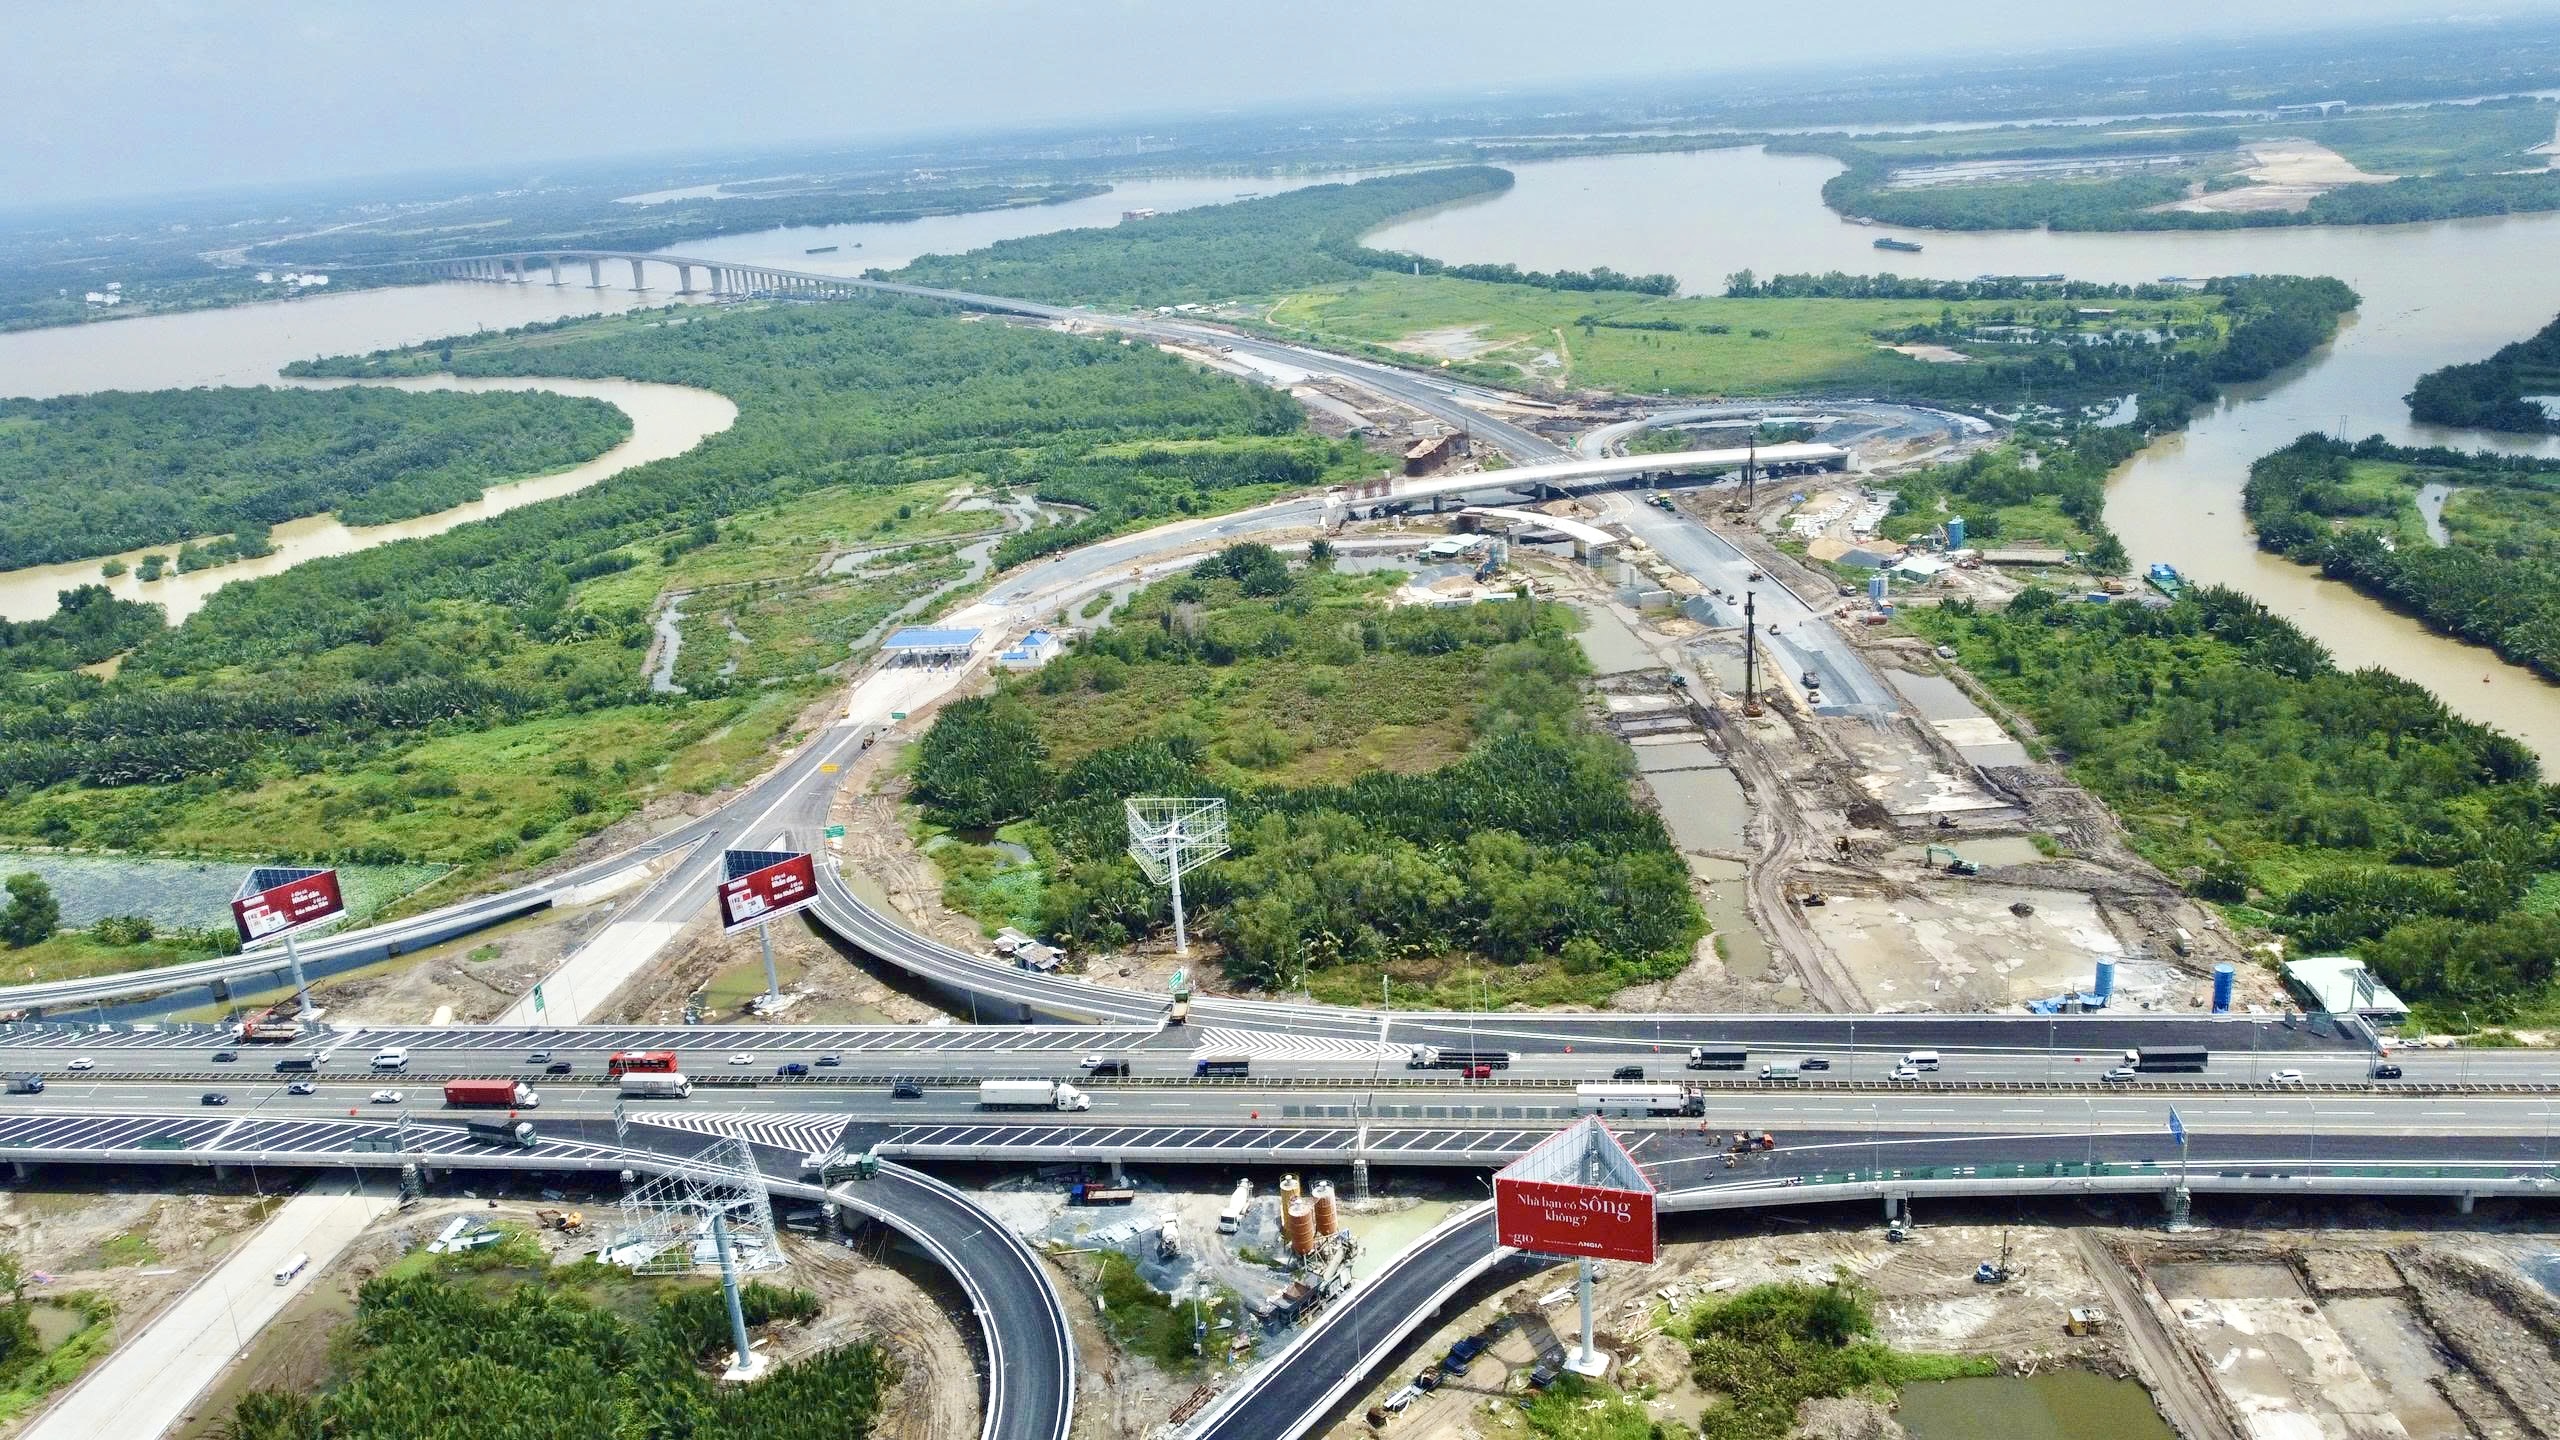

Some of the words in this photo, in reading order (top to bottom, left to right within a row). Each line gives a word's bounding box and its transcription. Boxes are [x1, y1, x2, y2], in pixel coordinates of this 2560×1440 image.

[1517, 1193, 1540, 1207] Nhà
[1542, 1195, 1562, 1211] bạn
[1564, 1198, 1577, 1210] có
[1579, 1195, 1632, 1224] sông
